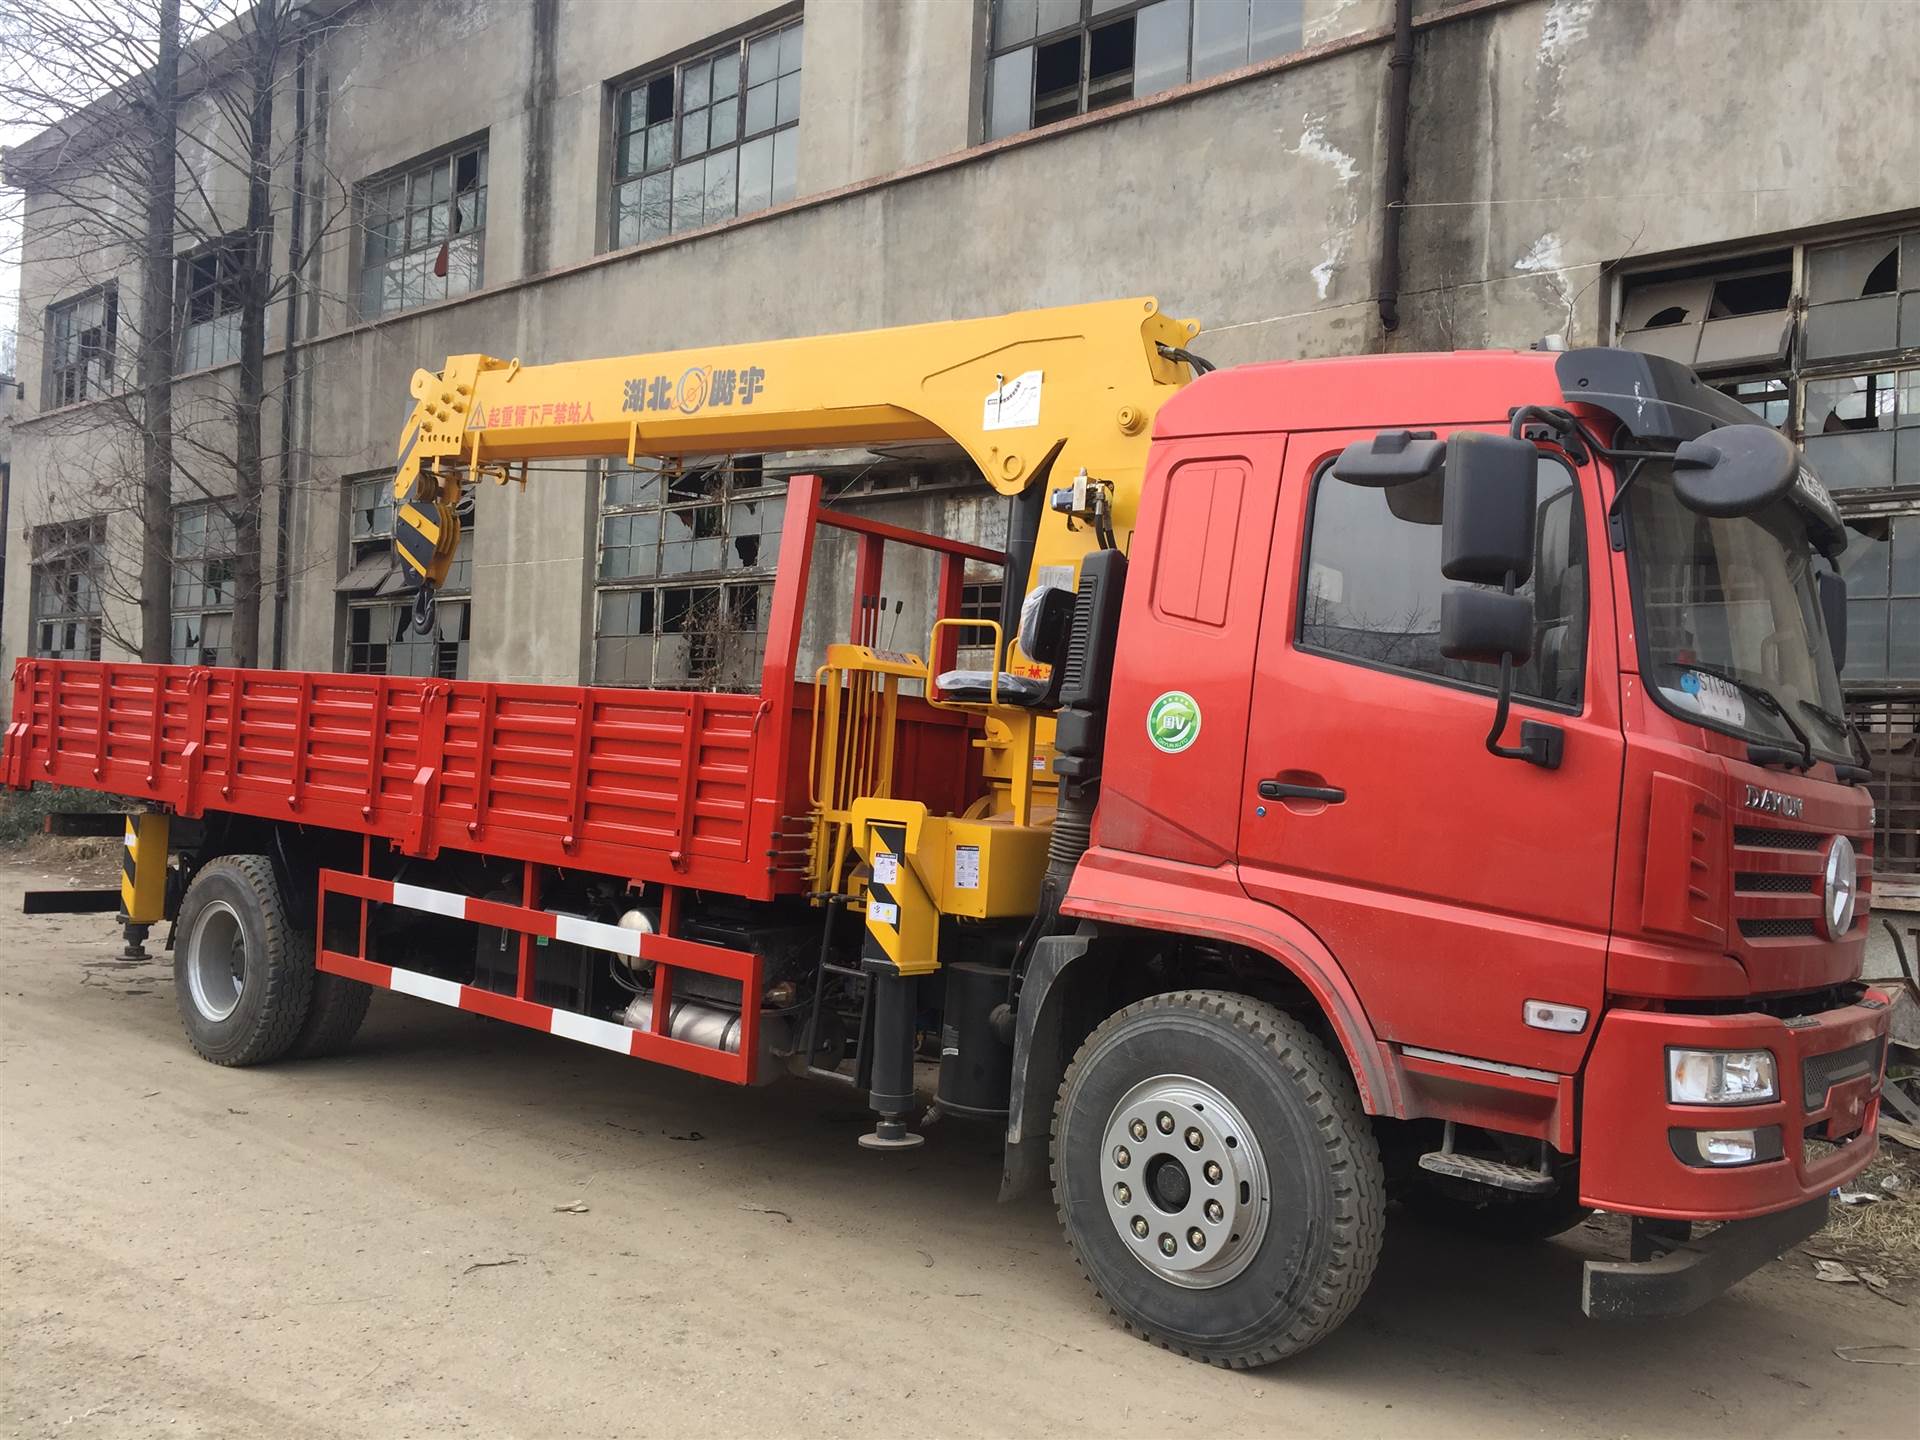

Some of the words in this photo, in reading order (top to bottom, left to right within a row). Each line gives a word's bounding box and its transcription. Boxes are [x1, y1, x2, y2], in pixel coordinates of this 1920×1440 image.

[622, 375, 673, 412] 湖北
[487, 401, 594, 428] 起重臂下严禁站人
